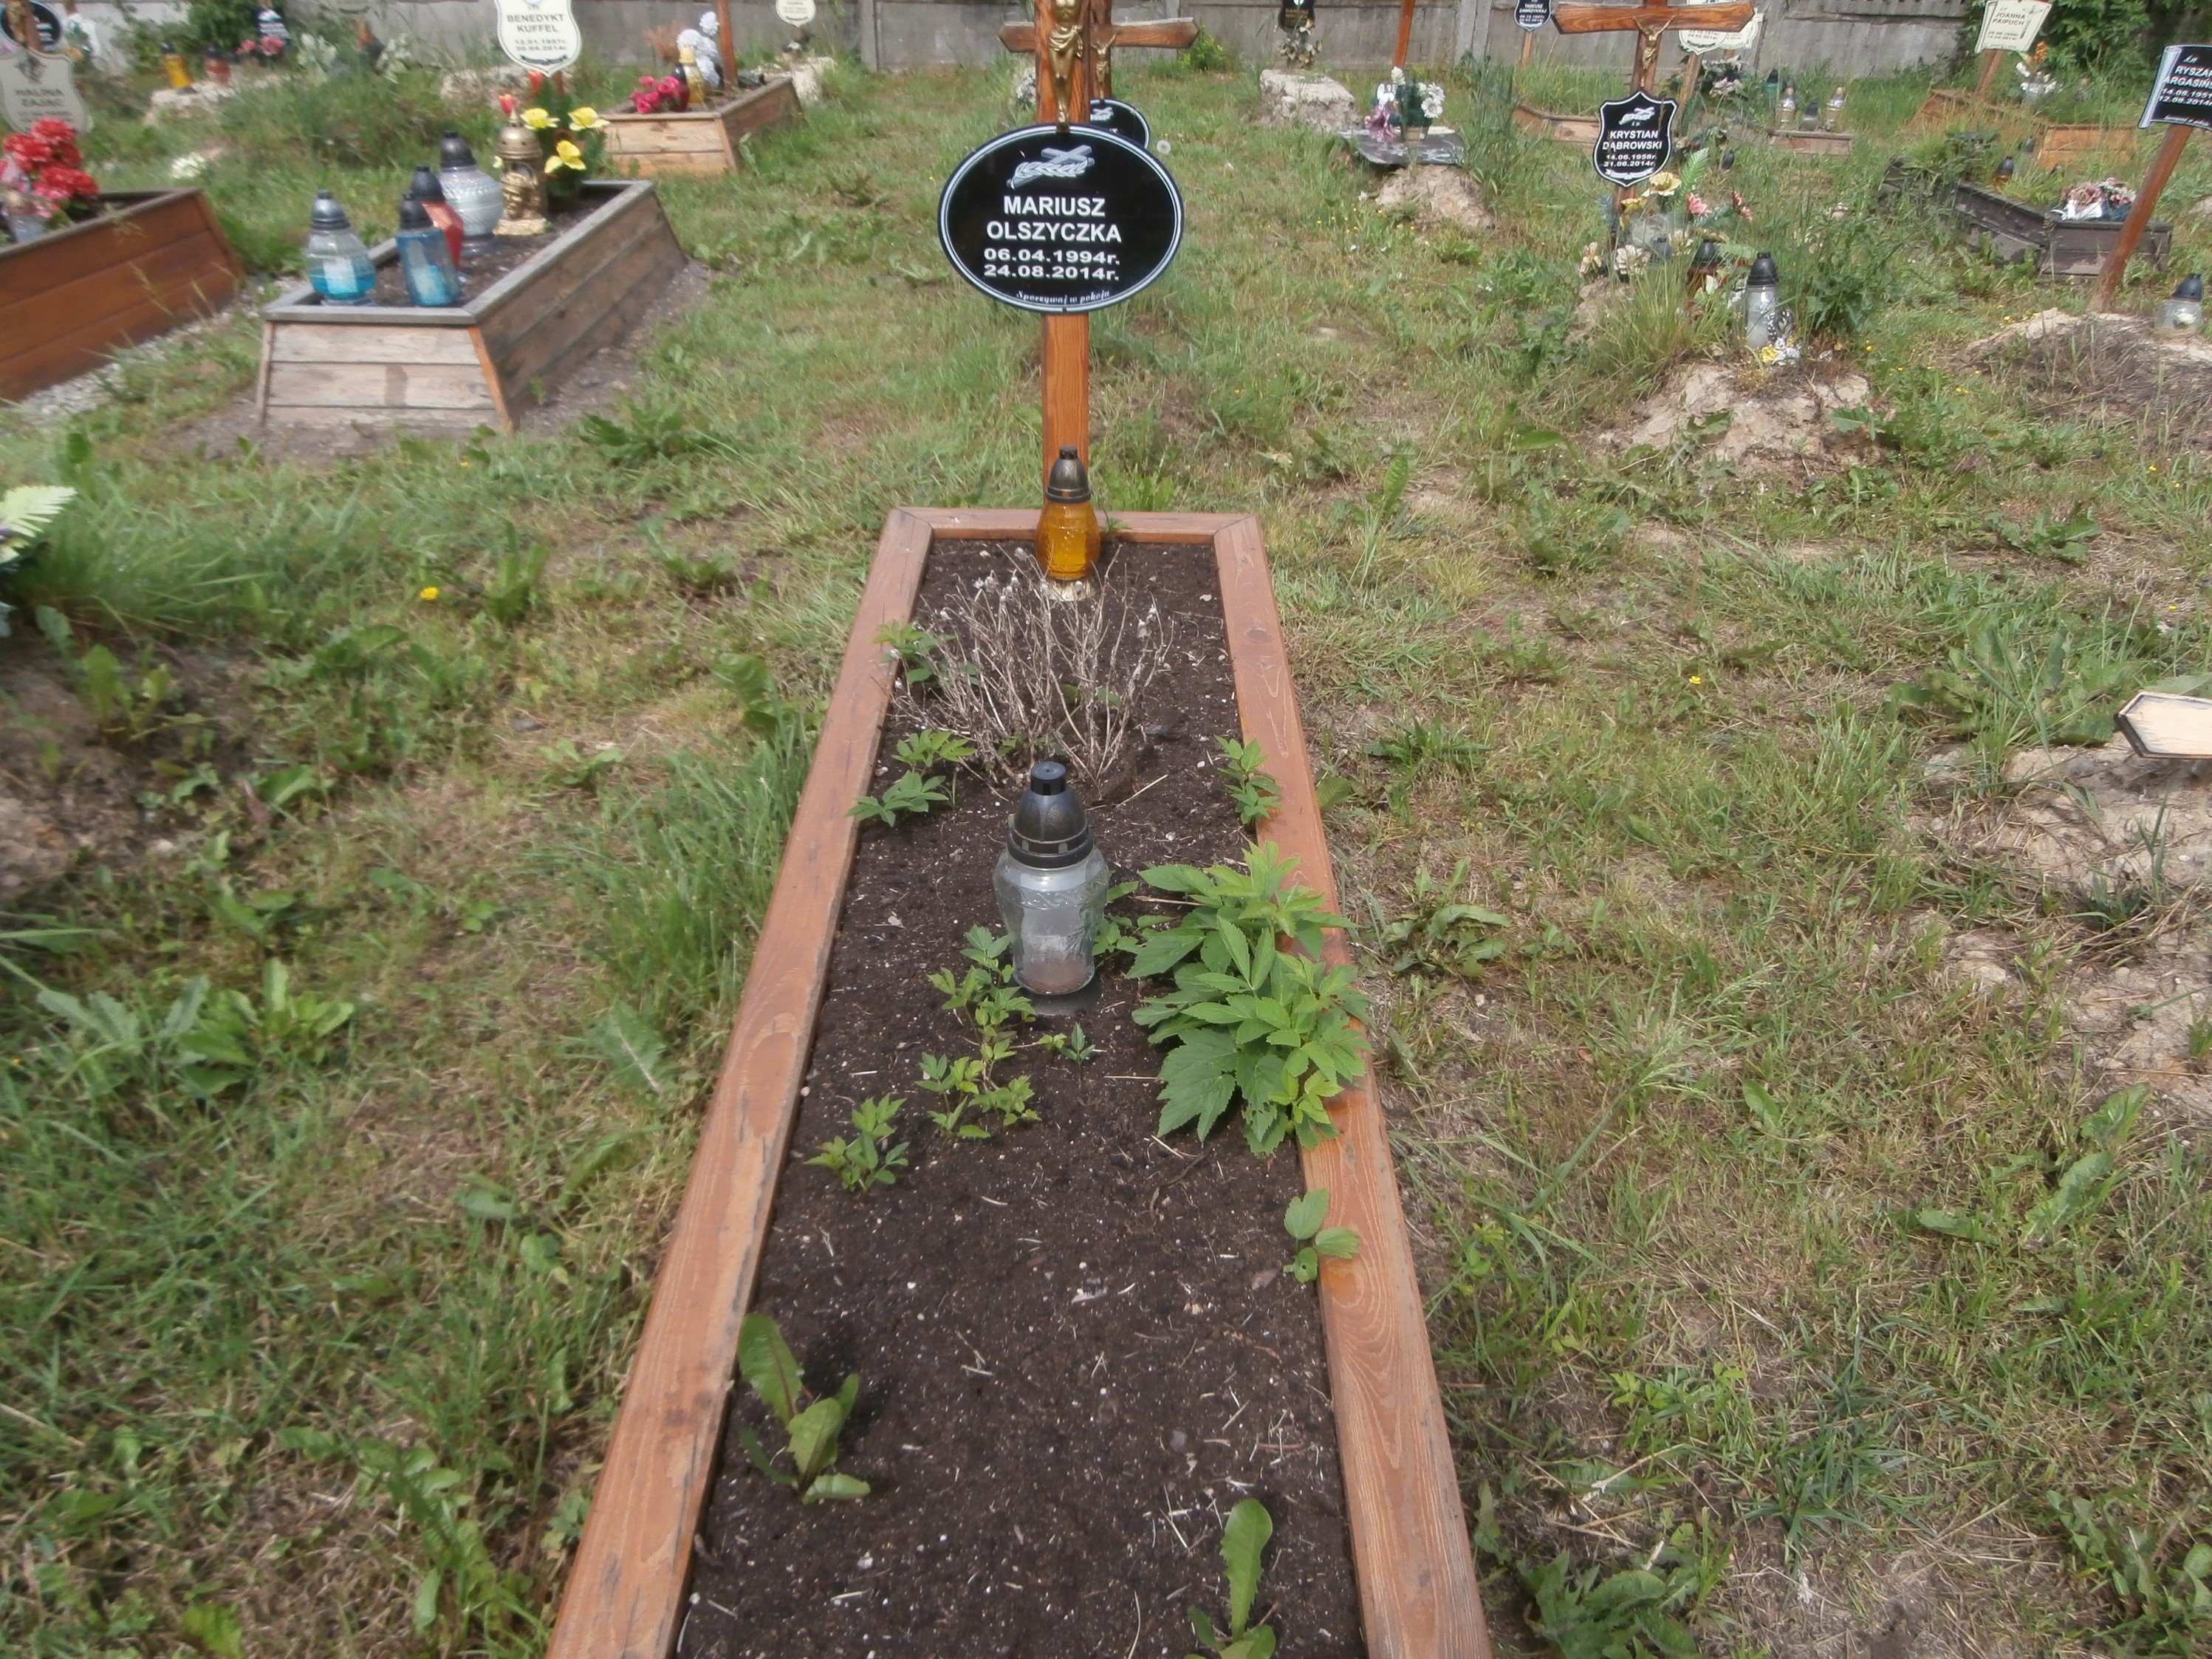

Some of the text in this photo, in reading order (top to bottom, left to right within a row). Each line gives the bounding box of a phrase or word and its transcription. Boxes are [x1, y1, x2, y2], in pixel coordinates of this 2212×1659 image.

[507, 14, 564, 23] BENEDYKT
[1996, 12, 2025, 20] JOANNA
[517, 24, 559, 33] KUFFEL
[1609, 130, 1659, 139] KRYSTIAN
[1602, 140, 1663, 152] DĄBROWSKI
[1003, 196, 1106, 217] MARIUSZ
[986, 221, 1122, 243] OLSZYCZKA
[983, 247, 1120, 265] 06.04.1994r.
[983, 264, 1120, 281] 24.08.2014r.
[1016, 290, 1068, 304] Spoczywaj
[1080, 289, 1109, 304] pokoju
